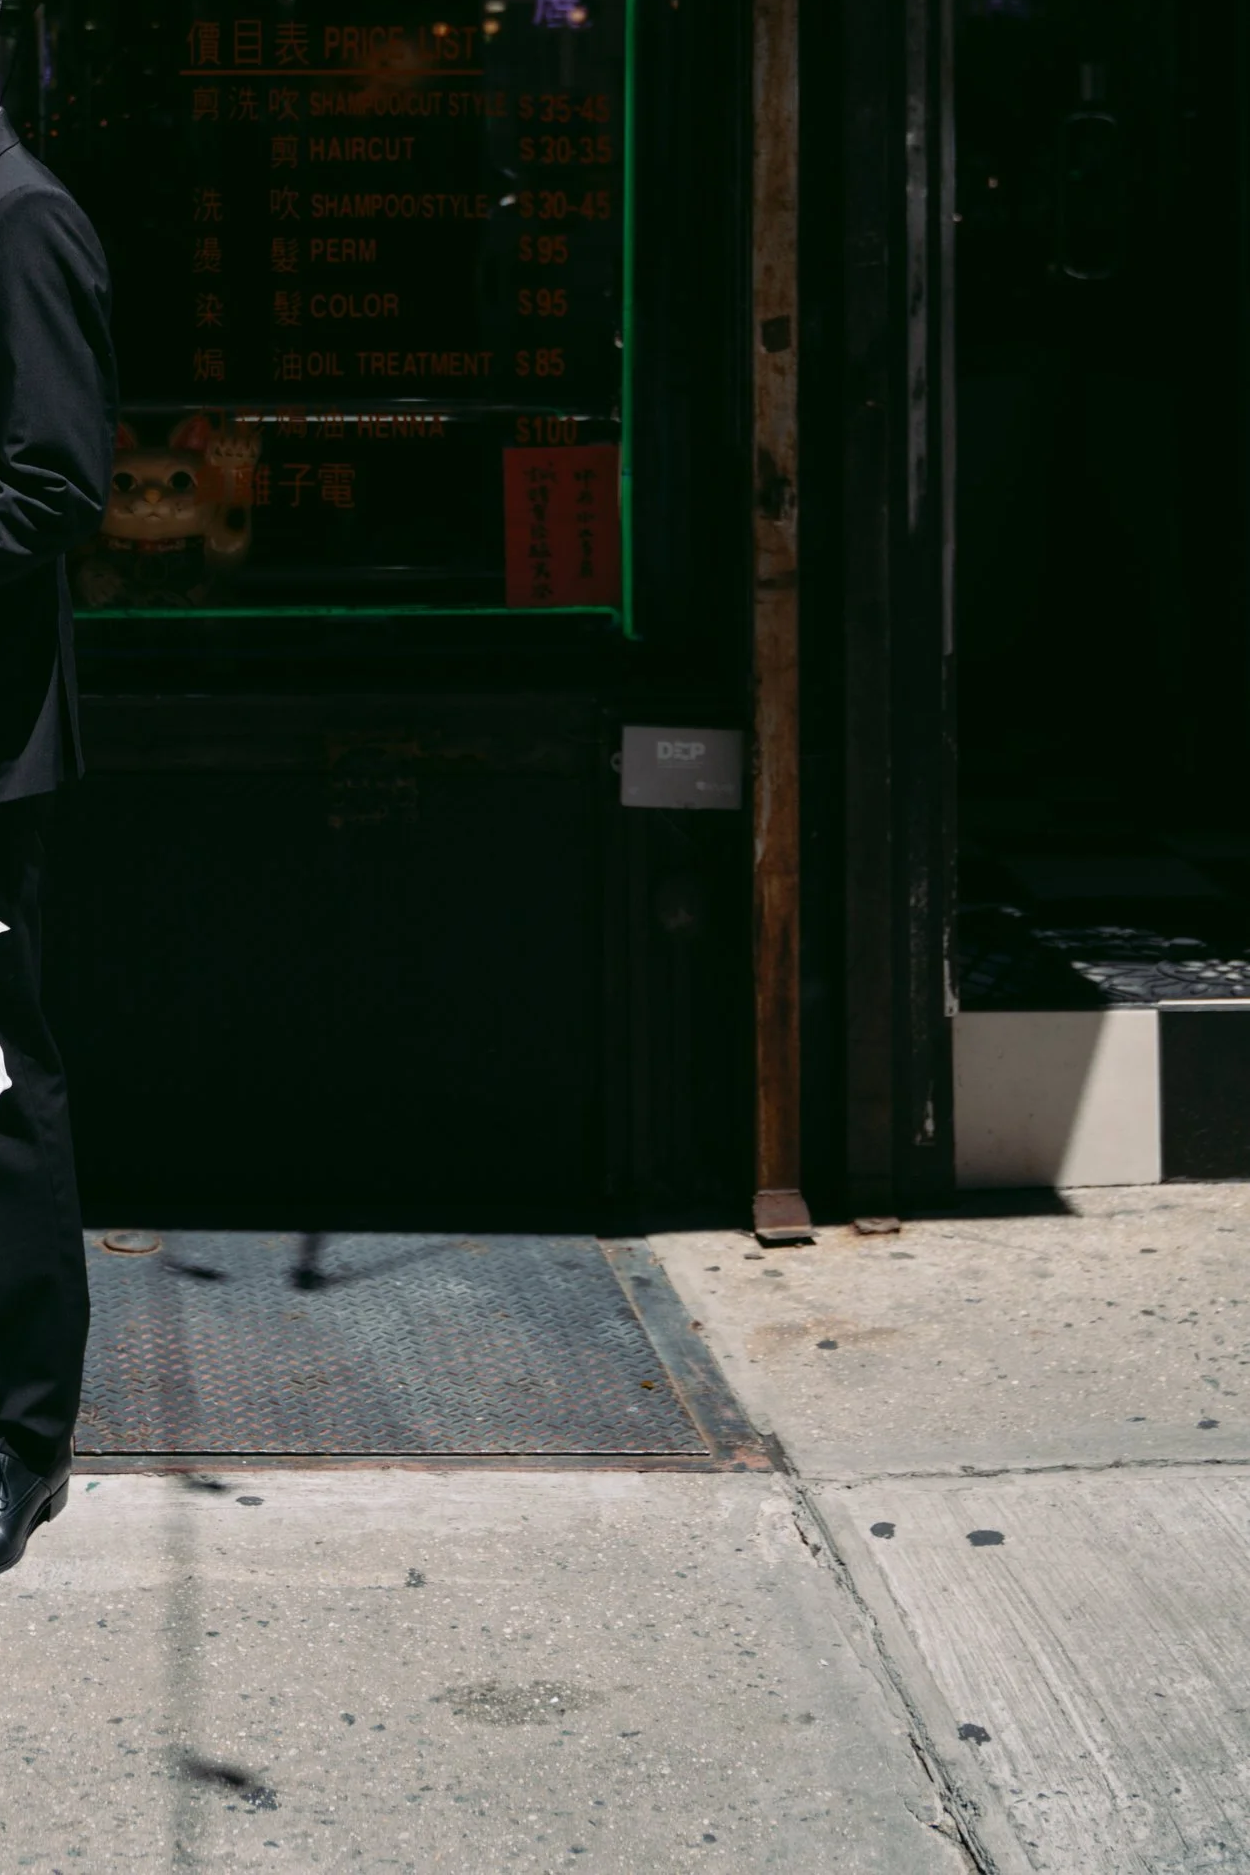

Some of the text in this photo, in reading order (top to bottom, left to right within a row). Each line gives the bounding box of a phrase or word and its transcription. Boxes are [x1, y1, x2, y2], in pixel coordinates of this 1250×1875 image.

[185, 18, 479, 67] 價目表 PRICE LIST
[308, 135, 417, 164] HAIRCUT
[309, 192, 490, 221] SHAMPOO/STYLE
[309, 237, 378, 264] PERM
[308, 292, 401, 319] COLOR
[305, 350, 346, 378] OIL
[354, 350, 496, 378] TREATMENT
